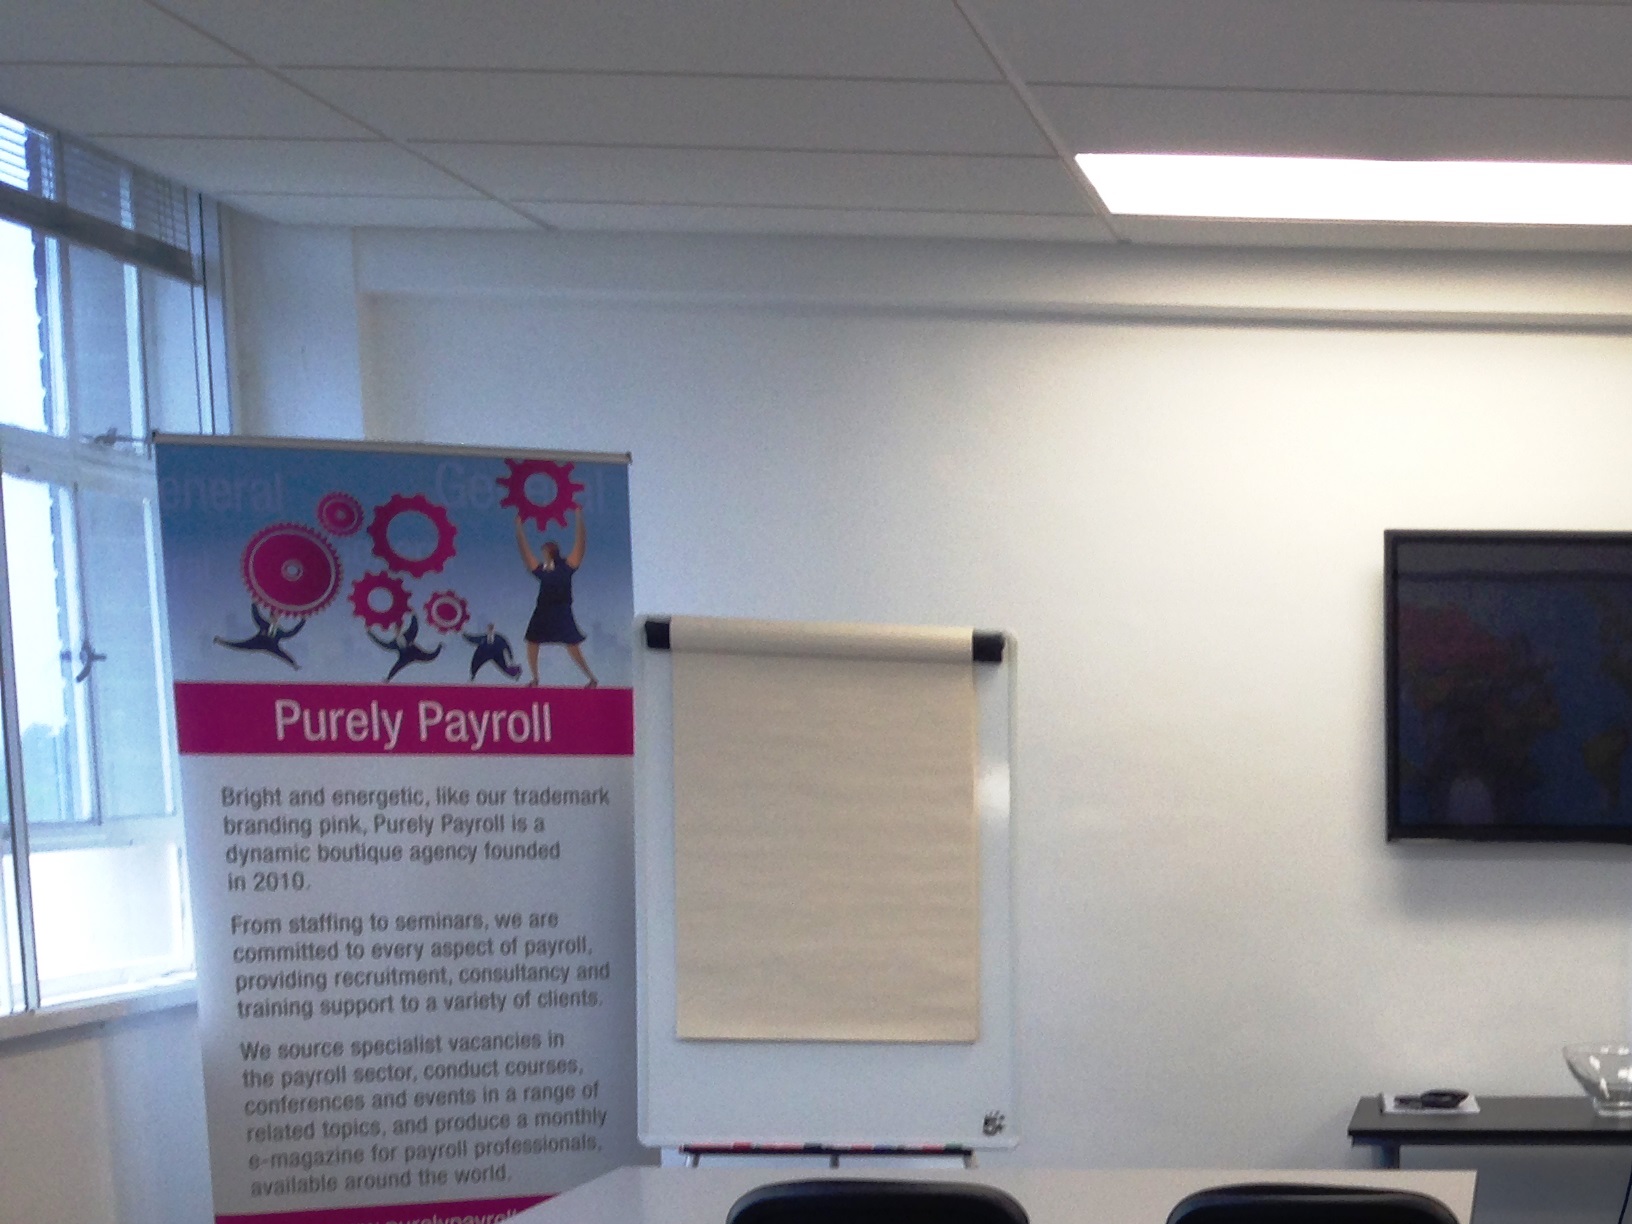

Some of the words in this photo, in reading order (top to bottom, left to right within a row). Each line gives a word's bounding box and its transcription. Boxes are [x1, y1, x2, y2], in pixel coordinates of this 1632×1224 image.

[275, 699, 404, 752] Purely
[418, 701, 553, 752] Payroll
[220, 785, 282, 811] Bright
[288, 785, 325, 806] and
[436, 785, 470, 806] like
[475, 788, 507, 806] our
[512, 785, 609, 806] trademark
[222, 813, 312, 839] branding
[373, 812, 434, 838] Purely
[440, 812, 505, 837] Payroll
[511, 814, 527, 833] is
[533, 817, 545, 833] a
[224, 842, 310, 868] dynamic
[317, 841, 403, 865] boutique
[409, 843, 477, 865] agency
[483, 839, 560, 860] founded
[227, 872, 246, 892] in
[230, 913, 282, 936] From
[288, 911, 363, 936] staffing
[368, 912, 389, 932] to
[493, 912, 522, 929] we
[528, 912, 558, 928] are
[232, 940, 339, 964] committed
[344, 940, 365, 960] to
[370, 942, 424, 962] every
[430, 937, 494, 960] aspect
[499, 935, 518, 956] of
[235, 969, 327, 995] providing
[458, 962, 570, 985] consultancy
[576, 961, 610, 981] and
[236, 997, 313, 1021] training
[319, 994, 394, 1019] support
[399, 993, 419, 1013] to
[425, 995, 437, 1012] a
[443, 989, 507, 1013] variety
[512, 988, 531, 1009] of
[238, 1040, 271, 1061] We
[277, 1039, 344, 1060] source
[349, 1034, 443, 1060] specialist
[447, 1031, 542, 1052] vacancies
[547, 1029, 565, 1048] in
[241, 1068, 274, 1091] the
[280, 1064, 346, 1092] payroll
[422, 1058, 499, 1081] conduct
[244, 1093, 365, 1116] conferences
[371, 1088, 407, 1110] and
[413, 1086, 476, 1107] events
[482, 1085, 499, 1104] in
[505, 1086, 517, 1103] a
[523, 1084, 576, 1105] range
[581, 1080, 598, 1100] of
[246, 1119, 315, 1143] related
[392, 1114, 428, 1136] and
[434, 1111, 510, 1136] produce
[516, 1112, 529, 1129] a
[534, 1106, 607, 1129] monthly
[248, 1145, 365, 1172] e-magazine
[370, 1142, 398, 1164] for
[403, 1139, 468, 1165] payroll
[250, 1170, 337, 1197] available
[344, 1168, 411, 1191] around
[417, 1167, 448, 1187] the
